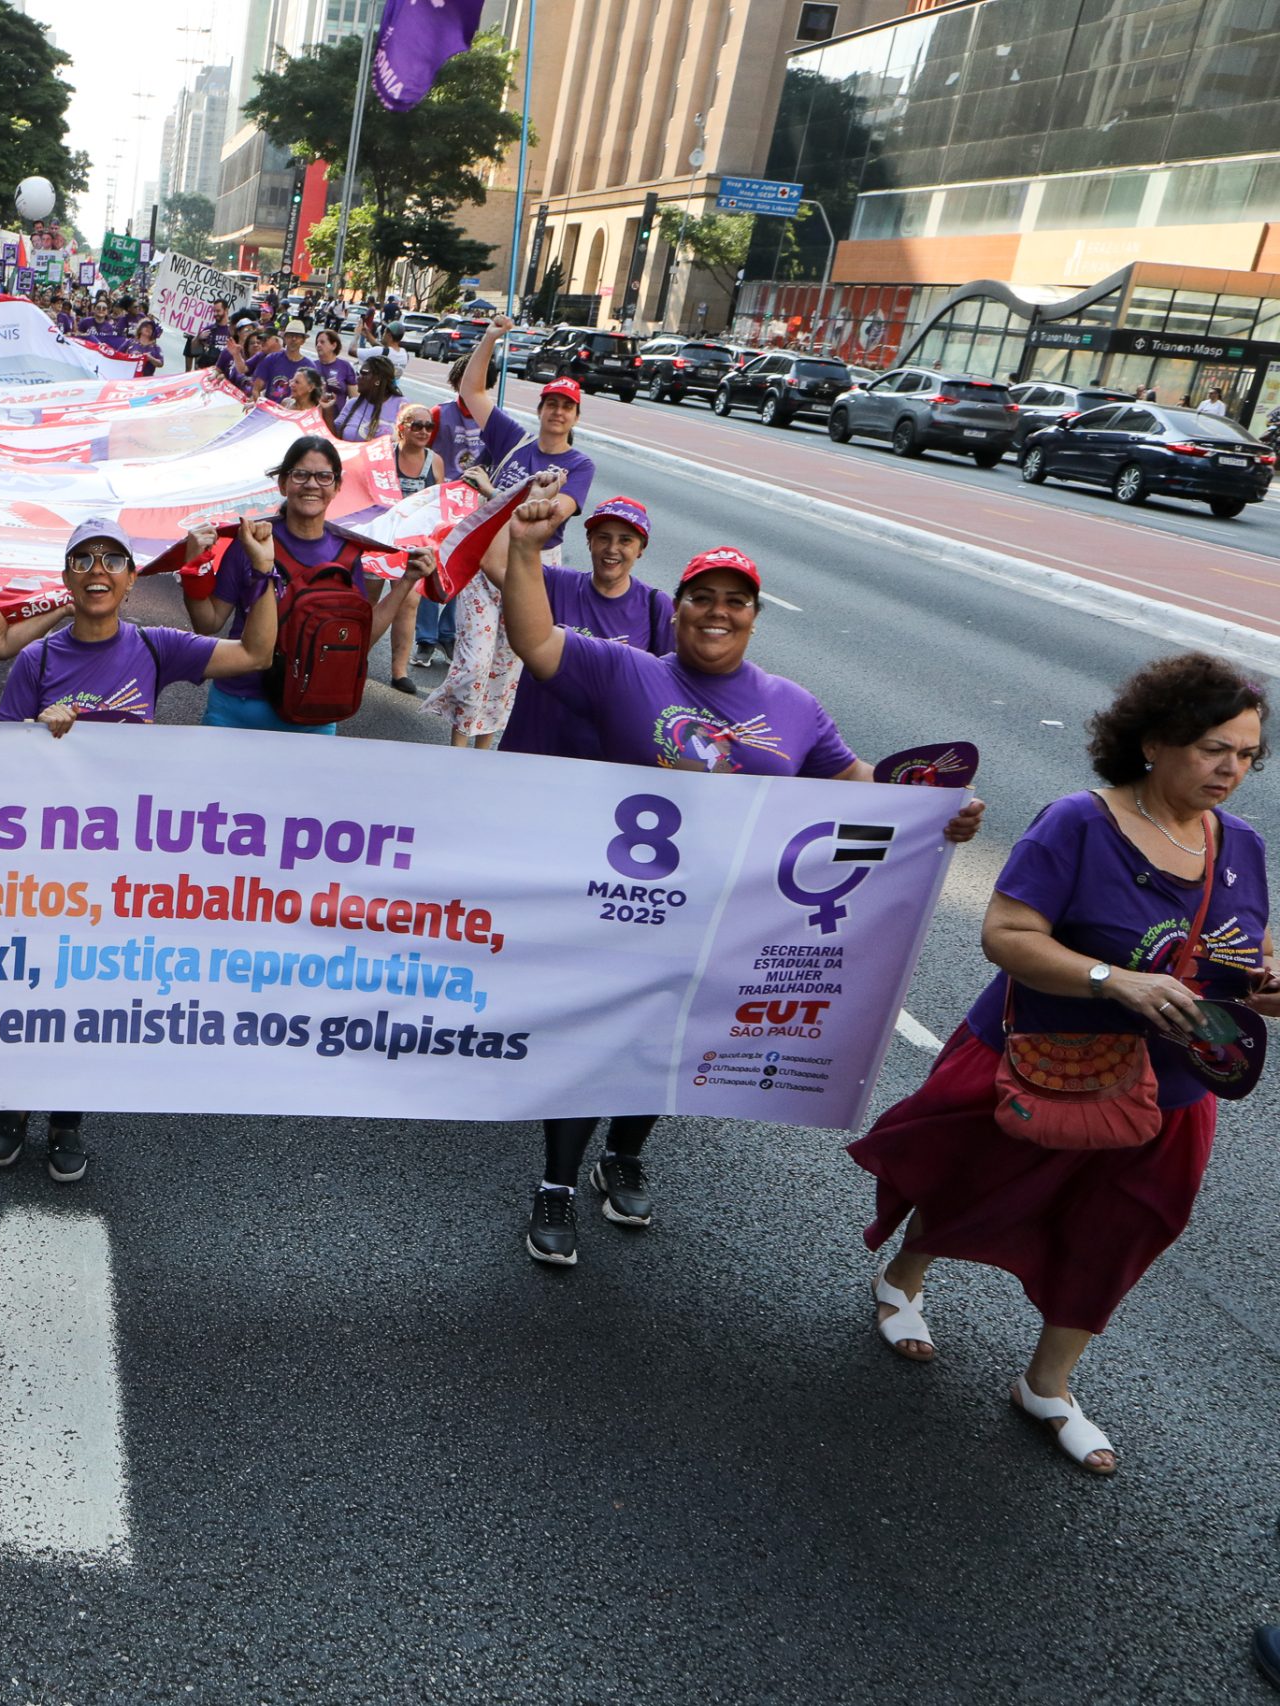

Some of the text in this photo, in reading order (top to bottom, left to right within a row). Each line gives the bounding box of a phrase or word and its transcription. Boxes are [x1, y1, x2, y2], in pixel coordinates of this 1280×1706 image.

[110, 236, 136, 252] PELA
[176, 278, 237, 311] AGRESSOR
[179, 296, 216, 322] APOIA
[169, 310, 203, 335] MULH
[1151, 340, 1223, 357] Trianon Masp
[21, 599, 51, 618] SÃO
[40, 805, 120, 851] na
[135, 794, 267, 857] luta
[280, 816, 415, 870] por:
[606, 793, 682, 881] 8
[586, 880, 687, 909] MARÇO
[111, 873, 302, 925] trabalho
[309, 882, 505, 954] decente,
[599, 903, 666, 925] 2025
[761, 945, 844, 957] SECRETARIA
[753, 958, 843, 969] ESTADUAL DA
[54, 935, 200, 995] justiça
[209, 945, 488, 1014] reprodutiva,
[765, 970, 823, 982] MULHER
[738, 983, 842, 995] TRABALHADORA
[735, 1000, 831, 1025] CUT
[73, 999, 225, 1046] anistia
[233, 1010, 311, 1047] aos
[316, 1010, 531, 1061] golpistas
[729, 1024, 822, 1039] SÃO PAULO
[781, 1054, 832, 1066] saopauloCUT
[779, 1067, 829, 1080] CUTsaopaulo
[774, 1081, 824, 1093] CUTsaopaulo
